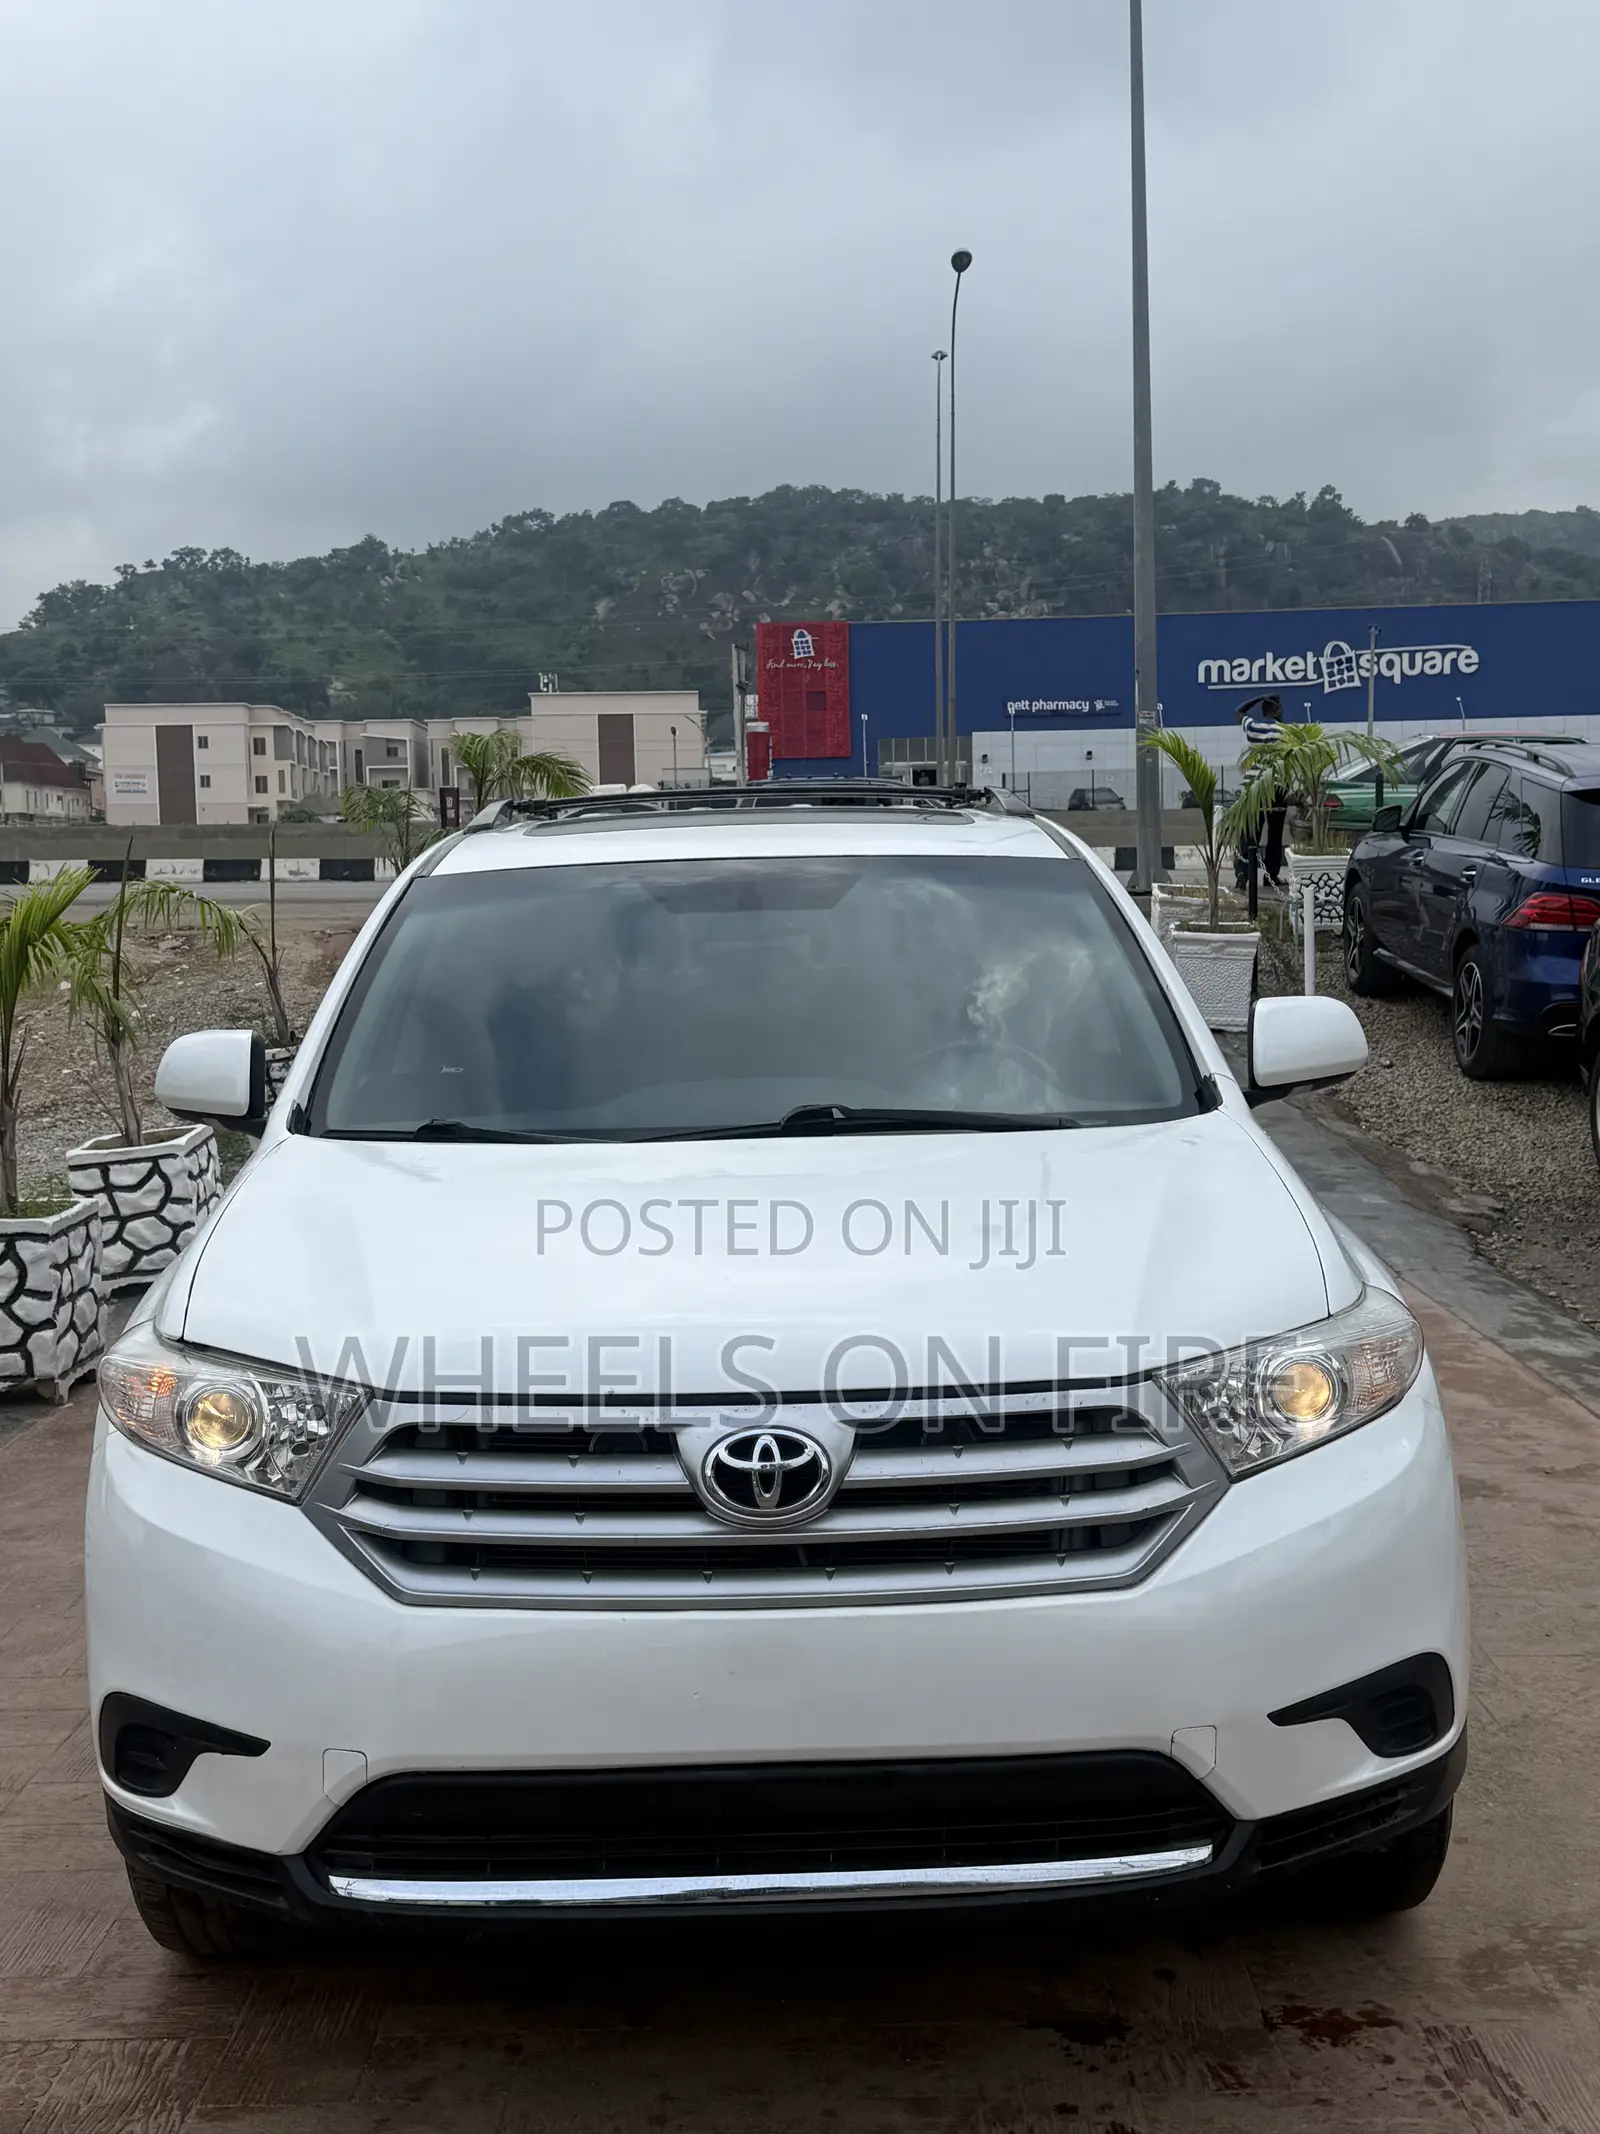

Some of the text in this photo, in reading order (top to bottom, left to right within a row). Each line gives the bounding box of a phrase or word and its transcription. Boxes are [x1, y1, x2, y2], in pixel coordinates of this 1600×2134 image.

[1198, 649, 1480, 684] market square
[1032, 699, 1089, 712] pharmacy
